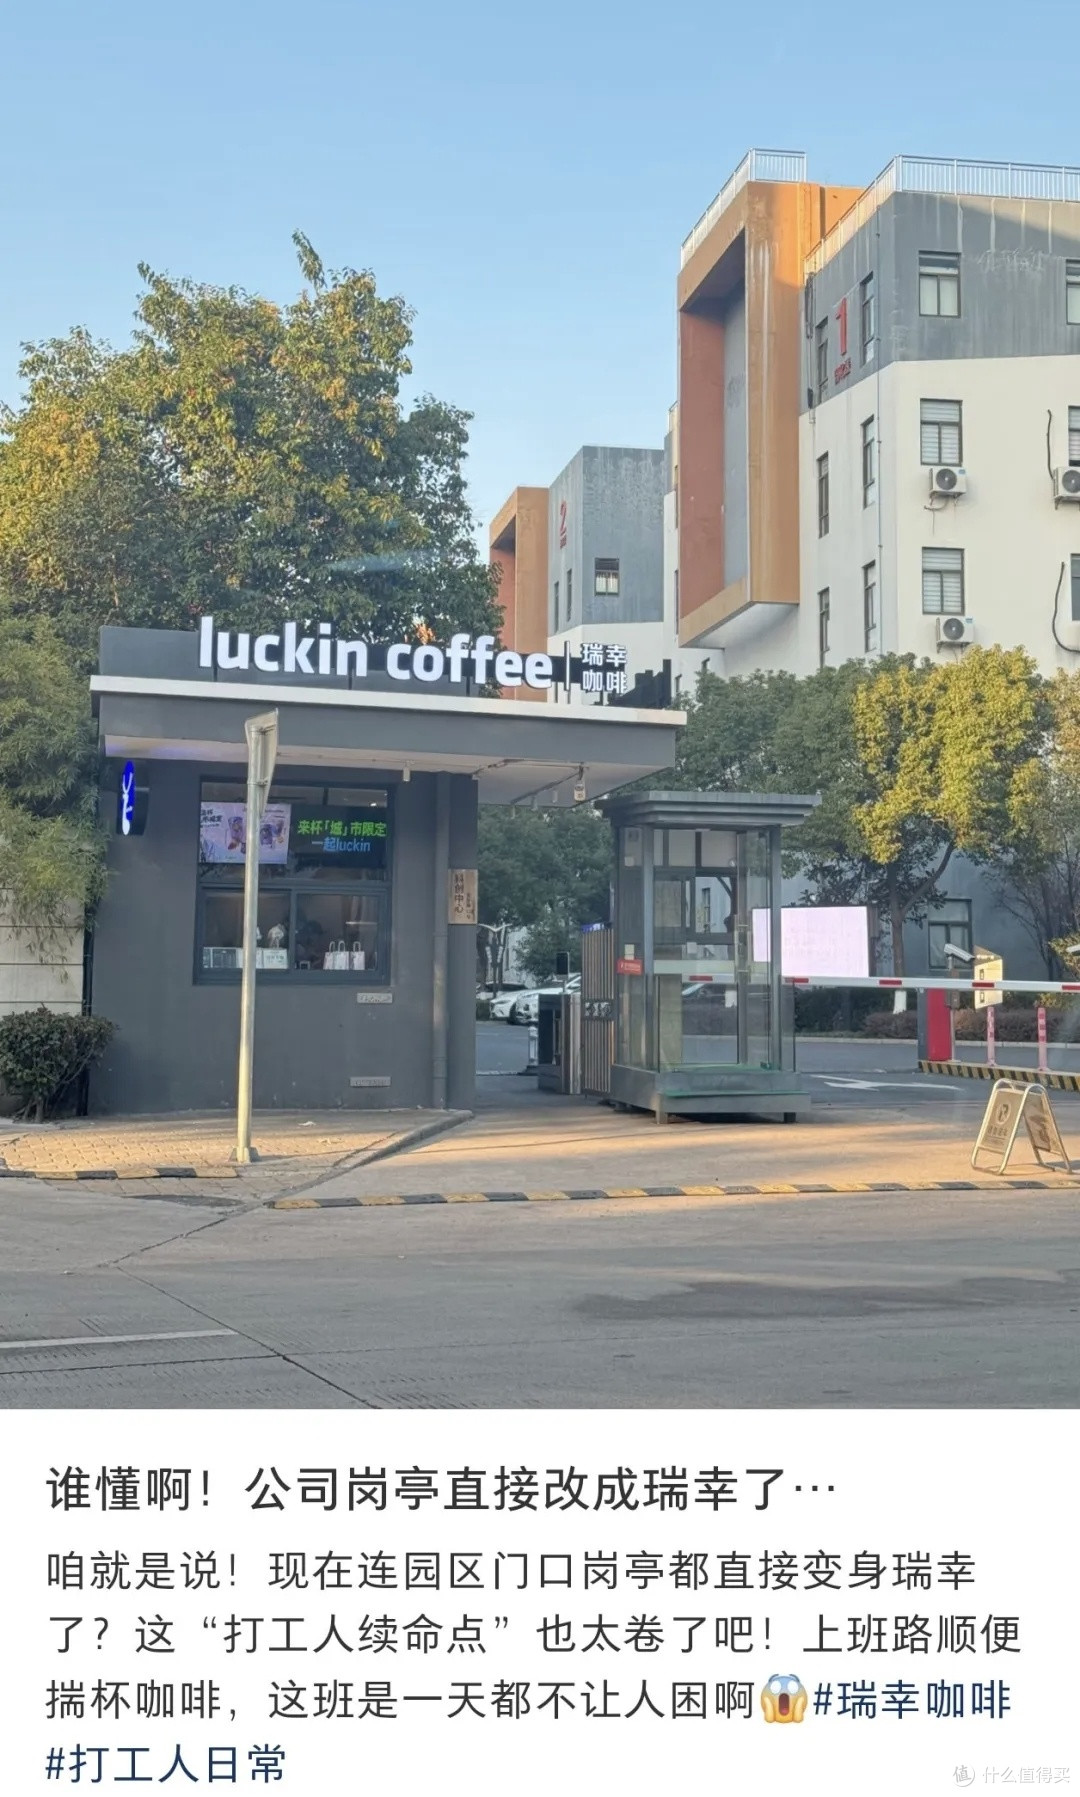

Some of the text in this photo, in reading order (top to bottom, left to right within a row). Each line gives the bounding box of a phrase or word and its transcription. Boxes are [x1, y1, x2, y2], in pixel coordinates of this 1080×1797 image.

[836, 297, 847, 356] 1
[560, 500, 567, 537] 2
[199, 615, 553, 688] luckin coffee
[580, 642, 628, 668] 瑞幸
[580, 670, 628, 694] 咖啡
